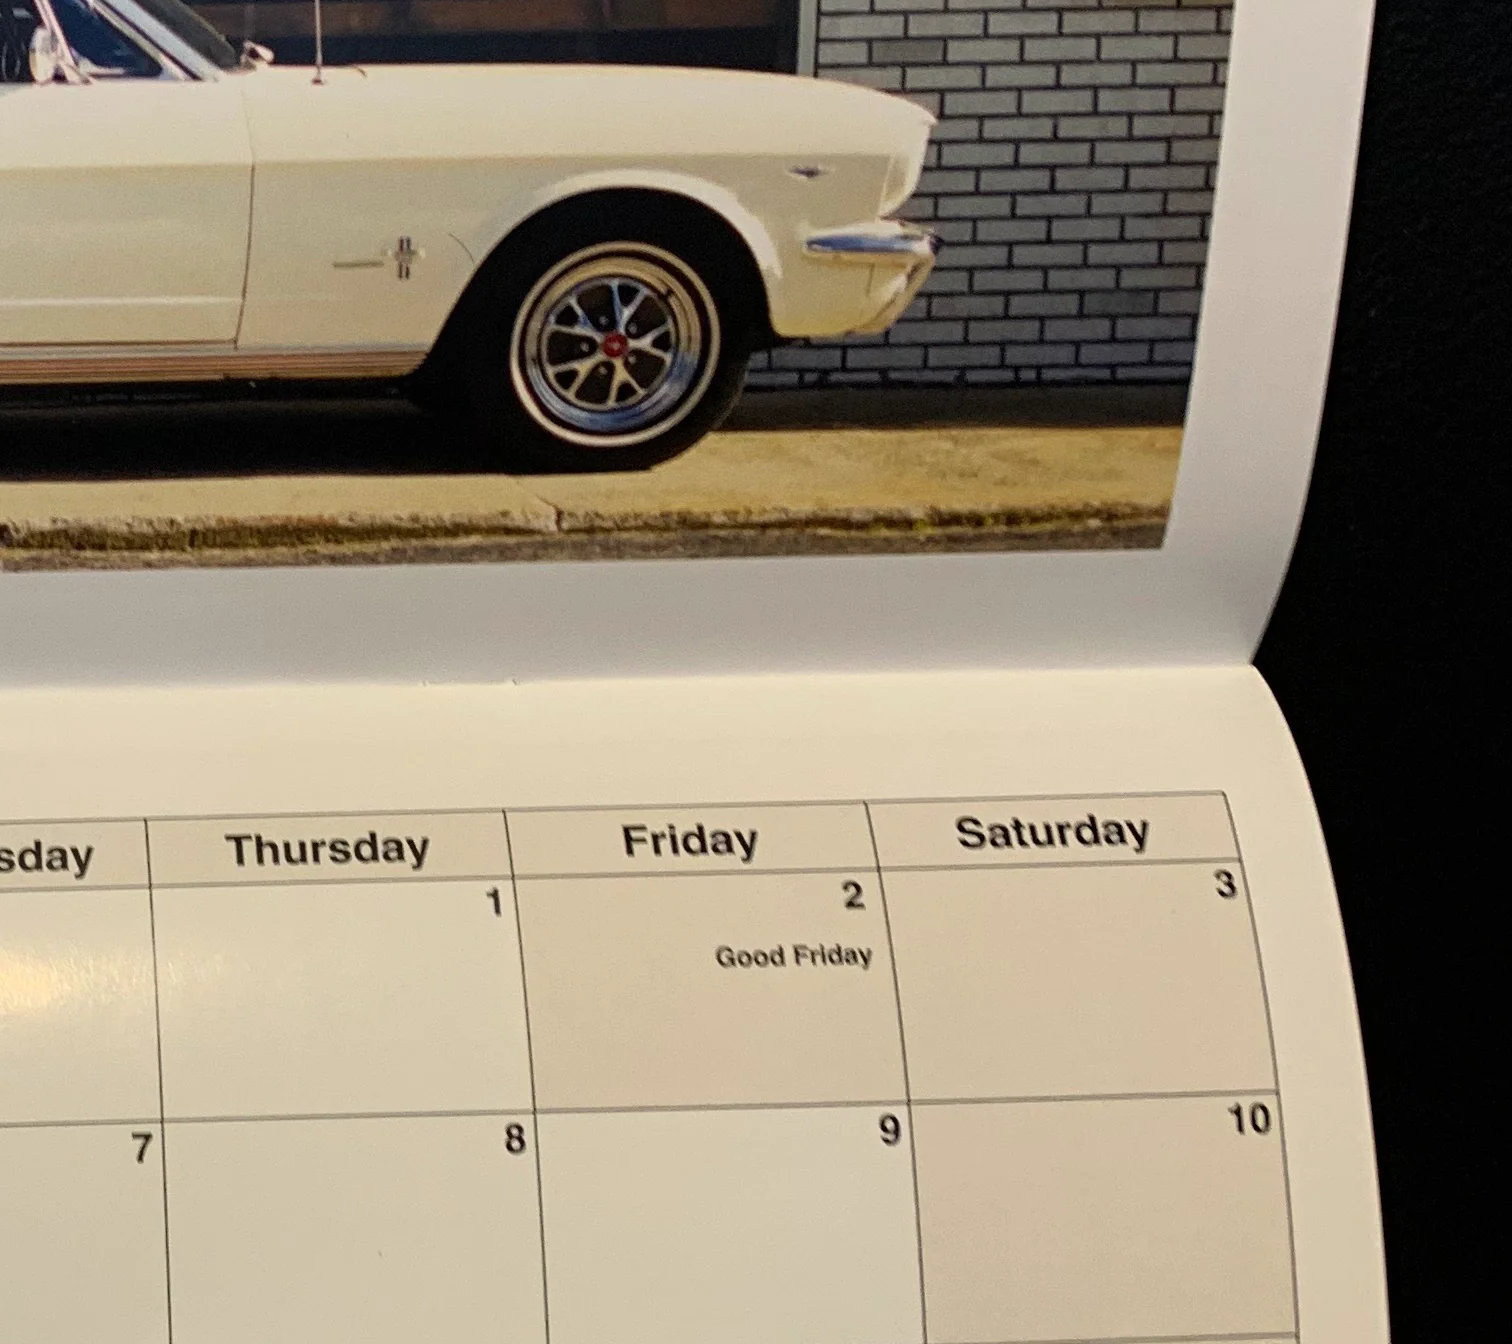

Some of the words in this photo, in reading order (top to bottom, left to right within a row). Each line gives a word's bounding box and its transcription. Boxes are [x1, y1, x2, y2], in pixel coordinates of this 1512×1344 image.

[225, 831, 429, 870] Thursday
[623, 824, 756, 862] Friday
[957, 815, 1148, 853] Saturday
[487, 888, 501, 915] 1
[843, 881, 864, 908] 2
[1216, 871, 1236, 898] 3
[716, 946, 785, 967] Good
[794, 944, 871, 969] Friday
[132, 1133, 152, 1162] 7
[506, 1124, 525, 1153] 8
[880, 1115, 900, 1145] 9
[1230, 1104, 1270, 1133] 10
